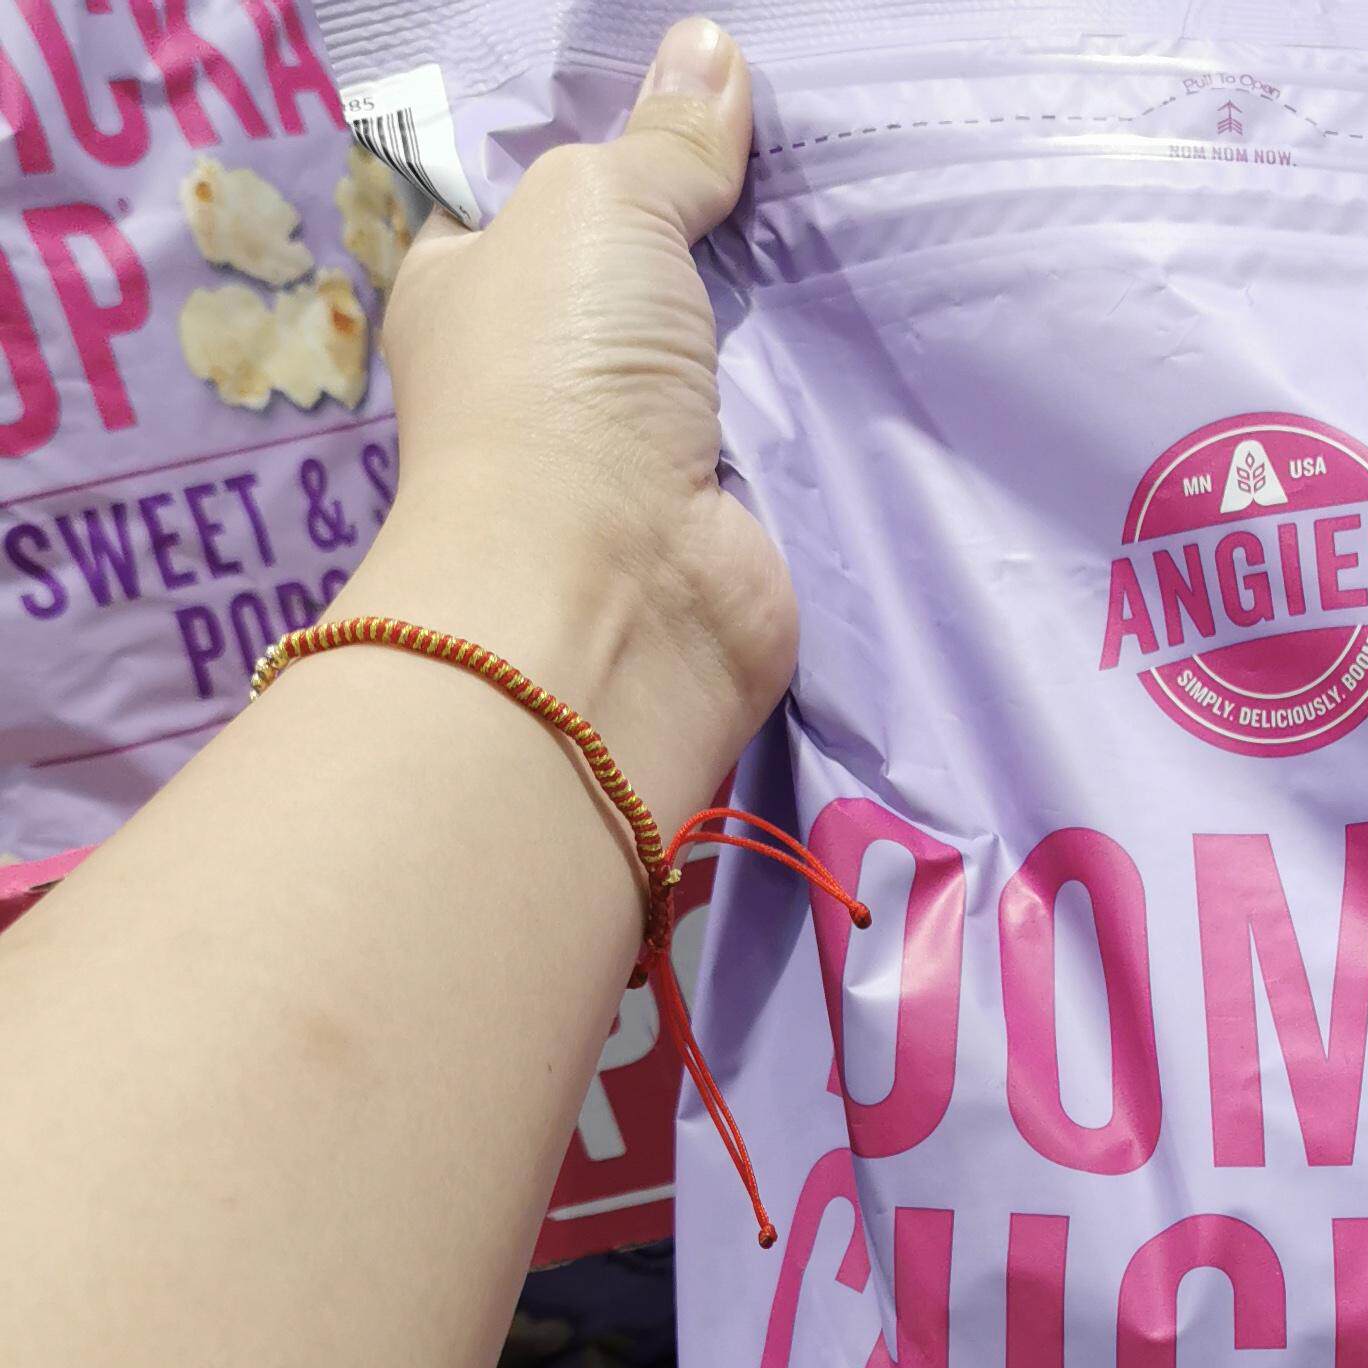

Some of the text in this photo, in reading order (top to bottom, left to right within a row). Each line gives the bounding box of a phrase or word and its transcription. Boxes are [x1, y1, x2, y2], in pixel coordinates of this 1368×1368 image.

[1183, 73, 1280, 99] Pull To Open
[1212, 146, 1249, 162] NOM
[1182, 456, 1327, 496] MN USA
[3, 473, 275, 620] SWEET
[303, 458, 359, 554] &
[1177, 669, 1234, 721] SIMPLY.
[1239, 685, 1346, 728] DELICIOUSLY.
